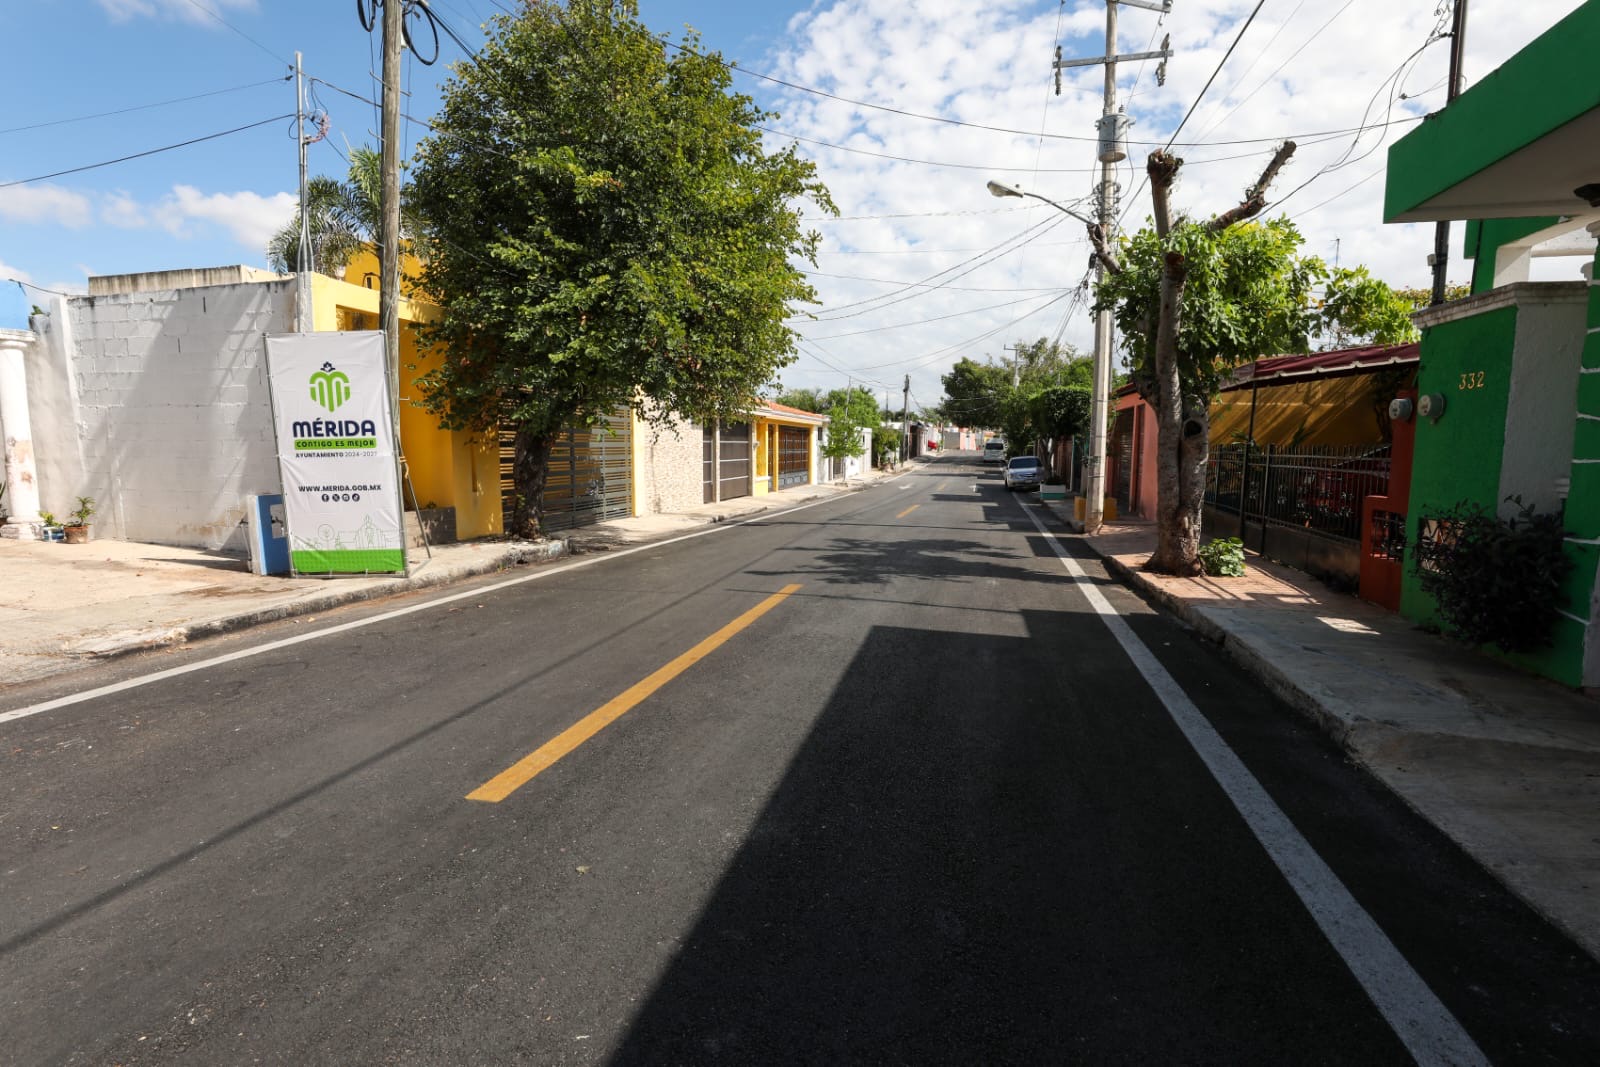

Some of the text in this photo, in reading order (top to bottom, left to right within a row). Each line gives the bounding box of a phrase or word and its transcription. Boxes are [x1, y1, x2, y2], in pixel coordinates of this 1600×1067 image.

[1459, 371, 1484, 389] 332
[293, 418, 376, 438] MÉRIDA
[296, 440, 332, 448] CONTIGO
[347, 439, 374, 447] MEJOR
[298, 484, 381, 492] WWW.MERIDA.GOB.MX
